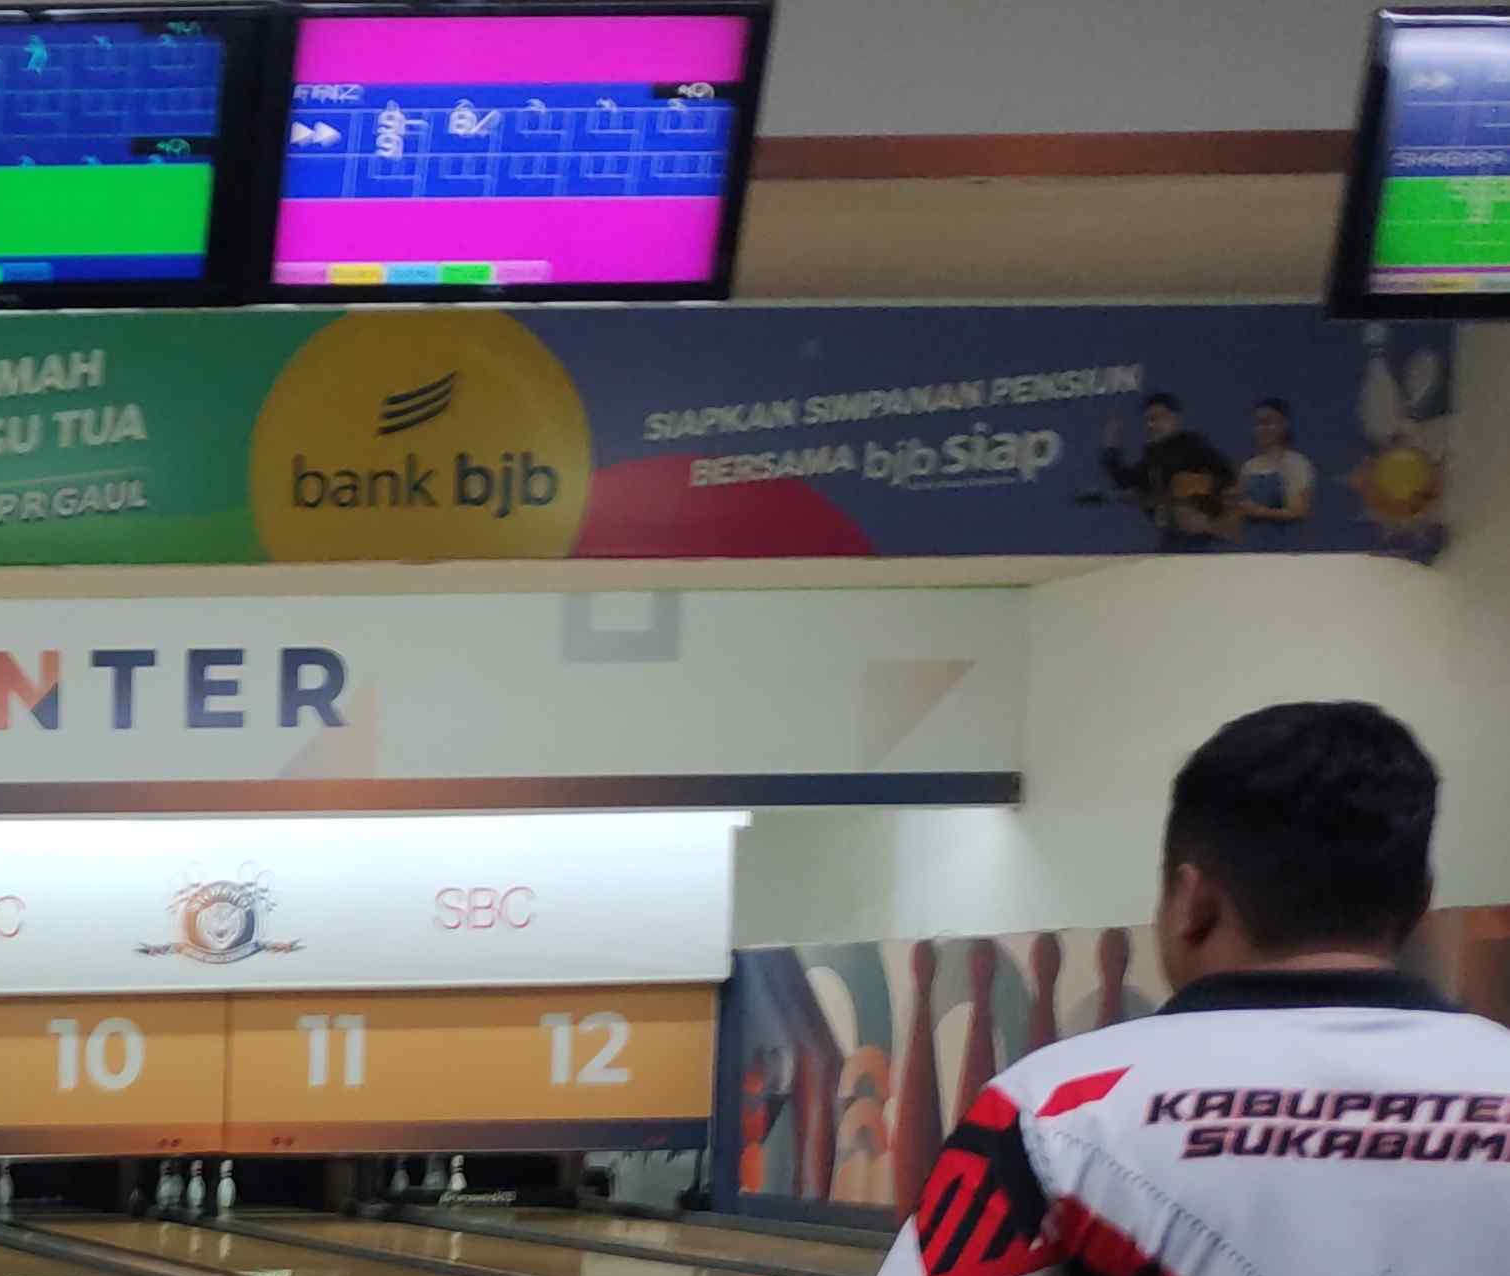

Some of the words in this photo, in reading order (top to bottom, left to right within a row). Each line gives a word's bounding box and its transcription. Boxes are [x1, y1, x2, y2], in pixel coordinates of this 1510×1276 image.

[52, 403, 148, 449] TUA
[643, 400, 795, 441] SIAPKAN
[802, 380, 985, 426] SIMPANAN
[990, 364, 1145, 404] PENSIUN
[292, 453, 439, 508] bank
[454, 451, 558, 518] bjb
[690, 444, 856, 487] BERSAMA
[863, 438, 939, 487] bjb
[941, 422, 1064, 482] siap
[433, 886, 537, 930] SBC
[46, 1017, 145, 1091] 10
[296, 1013, 367, 1087] 11
[539, 1010, 631, 1085] 12
